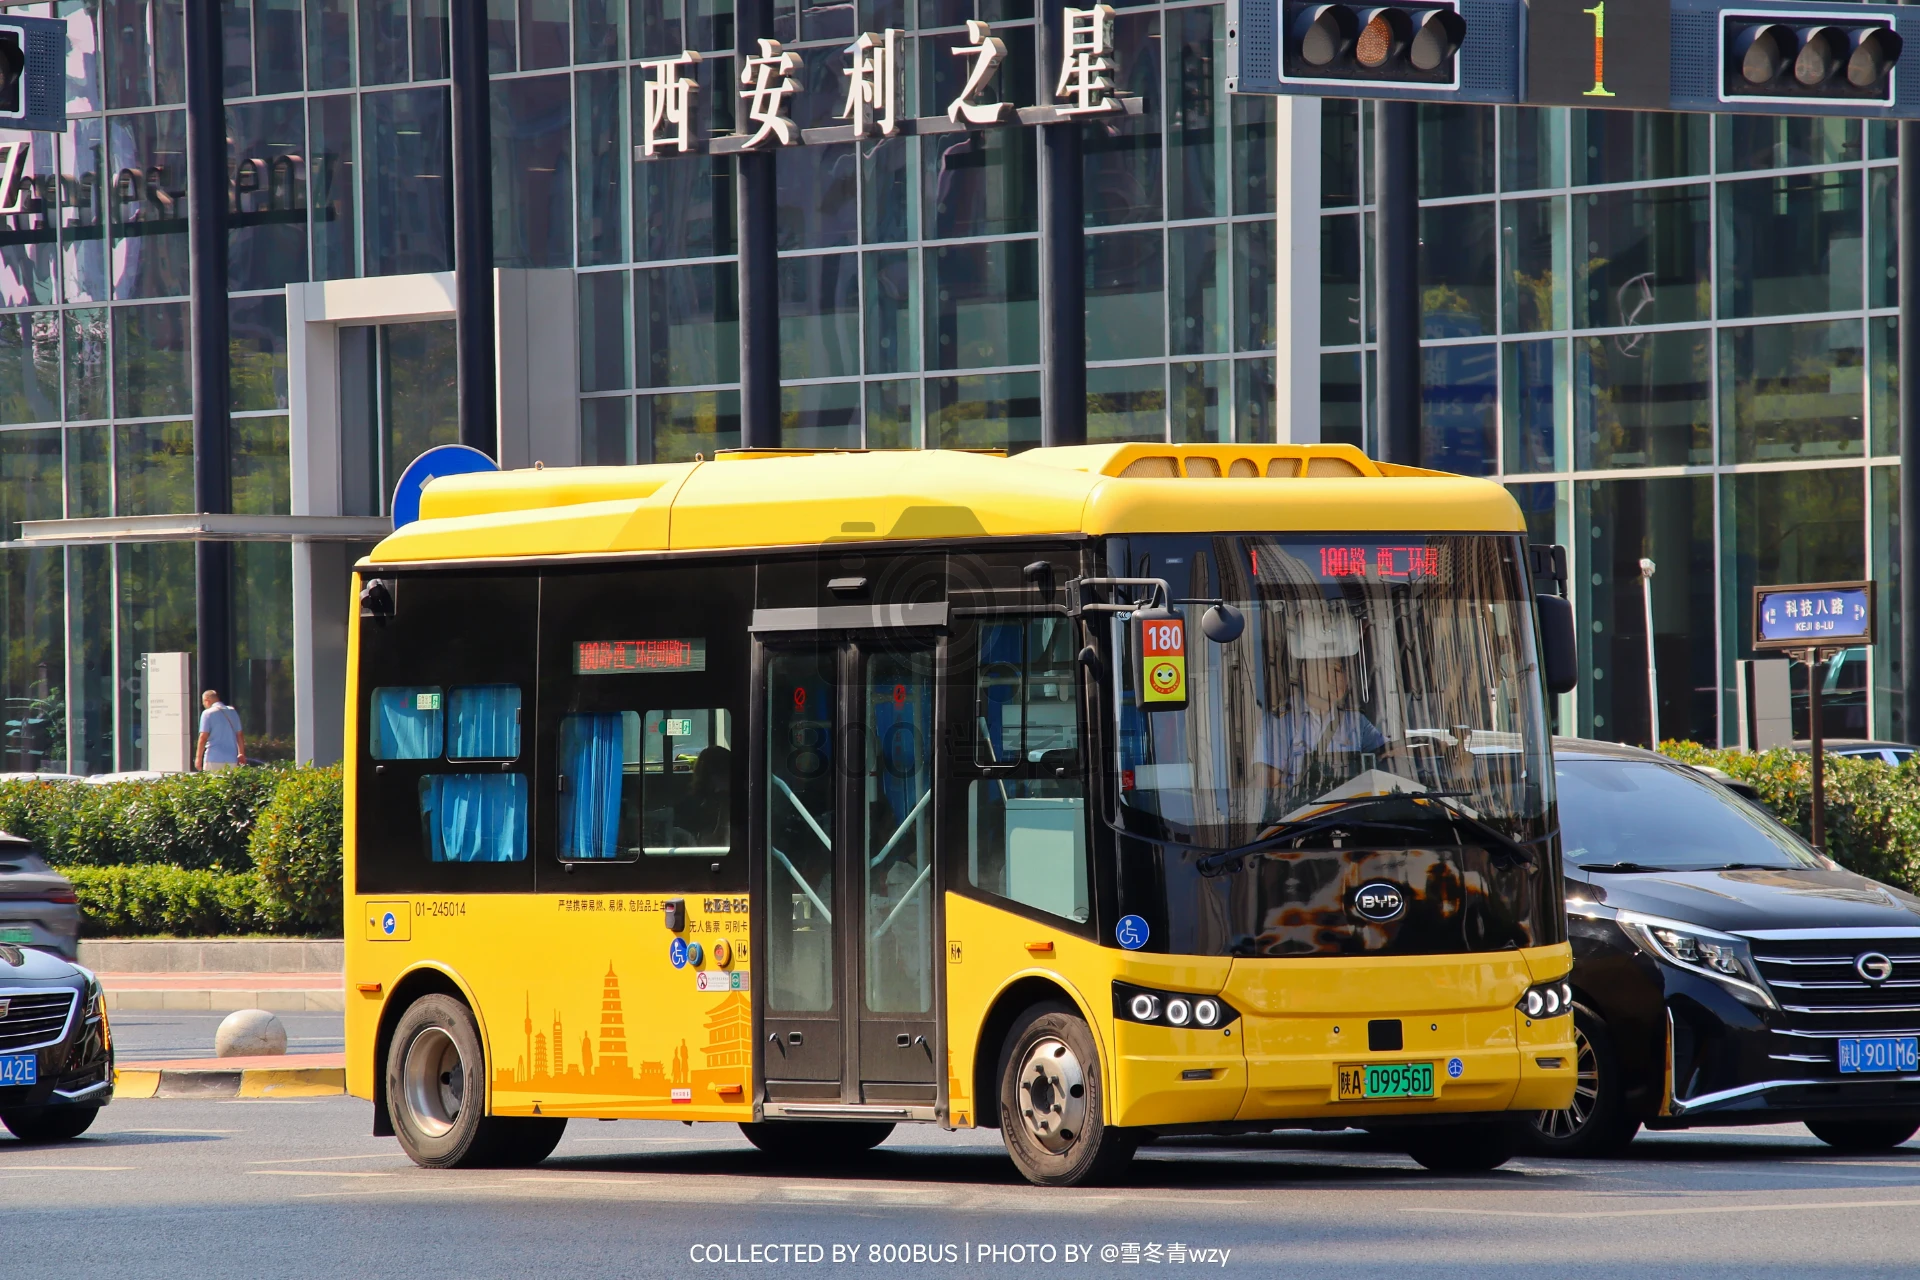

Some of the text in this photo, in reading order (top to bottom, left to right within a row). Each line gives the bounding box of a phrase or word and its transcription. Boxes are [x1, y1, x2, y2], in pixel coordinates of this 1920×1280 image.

[1583, 6, 1615, 97] 1
[640, 5, 1114, 155] 西安利之星
[1319, 546, 1366, 577] 180路
[1785, 598, 1844, 617] 科技八路
[1795, 621, 1834, 631] KEJI 8-LU
[1148, 625, 1182, 650] 180
[415, 902, 466, 917] 01-245014
[1362, 894, 1399, 909] BYD
[689, 920, 748, 933] 无人售票 可刷卡
